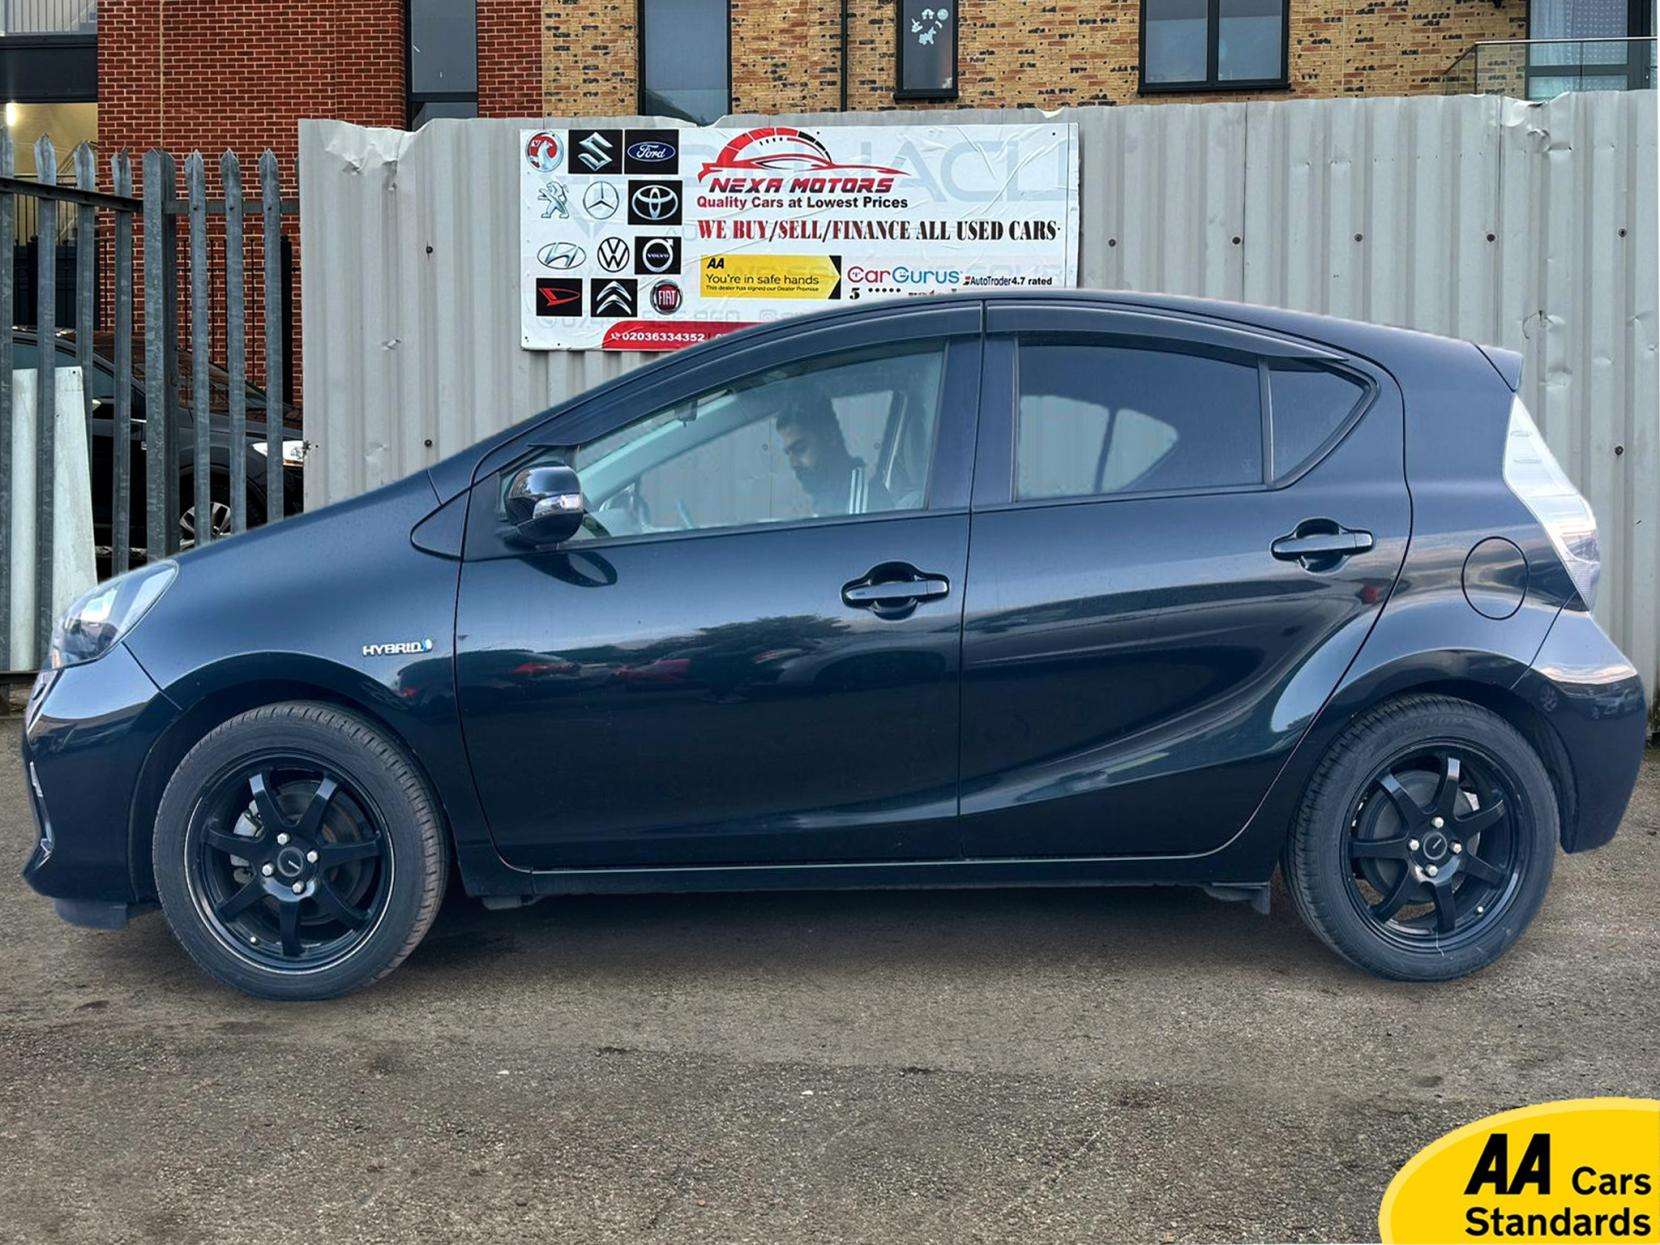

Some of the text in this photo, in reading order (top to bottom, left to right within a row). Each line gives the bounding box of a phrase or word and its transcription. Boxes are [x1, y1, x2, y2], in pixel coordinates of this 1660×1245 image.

[636, 145, 666, 158] Ford
[709, 178, 895, 193] NEXA MOTORS
[697, 196, 908, 210] Quality Cars at Lowest Prices
[698, 220, 727, 239] WE
[915, 221, 951, 239] ALL
[956, 221, 1004, 239] USED
[706, 258, 725, 269] AA
[706, 274, 819, 285] You're in safe hands
[847, 266, 960, 284] CarGurus
[1028, 276, 1052, 286] rated
[658, 290, 676, 306] FIAT
[850, 287, 860, 300] 5
[622, 332, 705, 342] 02036334352
[362, 641, 422, 656] HYBRID
